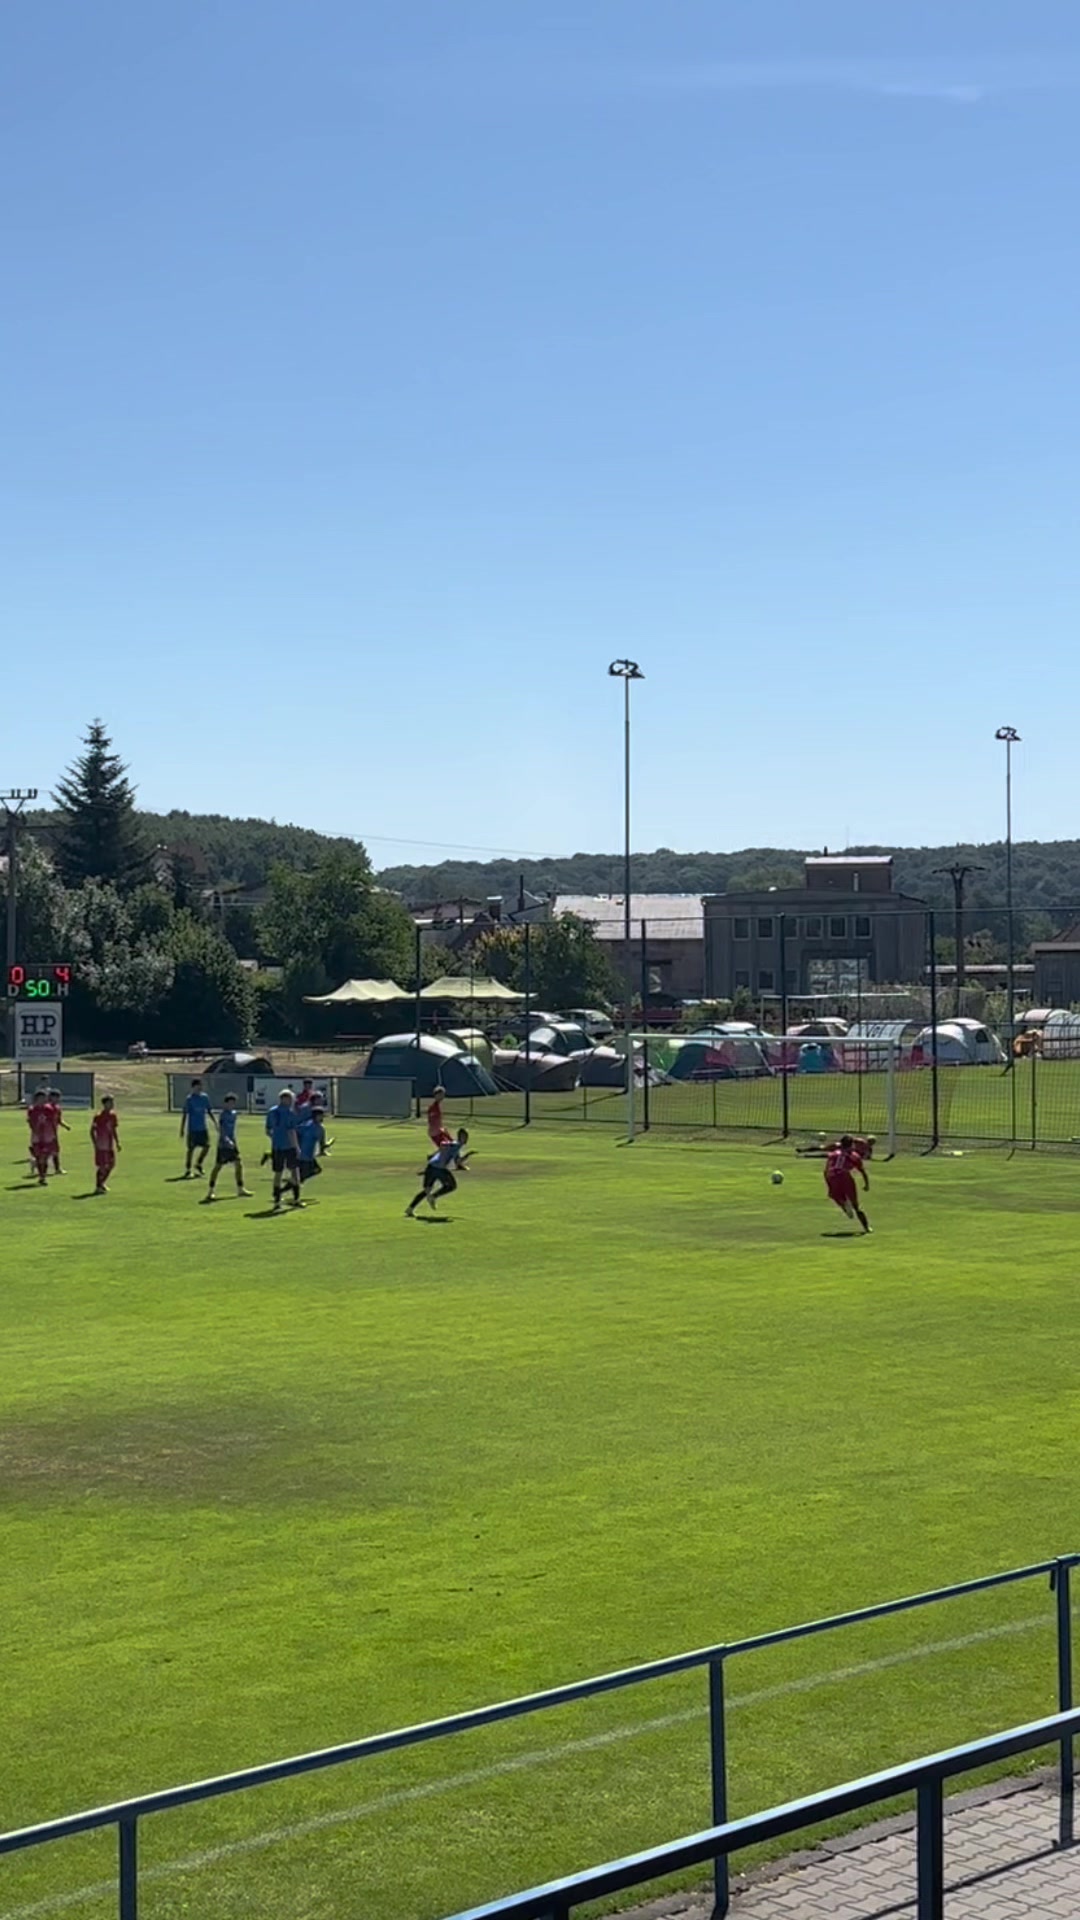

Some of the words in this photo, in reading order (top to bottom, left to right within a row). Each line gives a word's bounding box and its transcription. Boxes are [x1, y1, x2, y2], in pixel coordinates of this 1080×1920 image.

[56, 967, 69, 981] 4
[8, 984, 19, 997] D
[58, 983, 68, 996] H
[20, 1015, 56, 1035] HP
[20, 1038, 57, 1047] TREND
